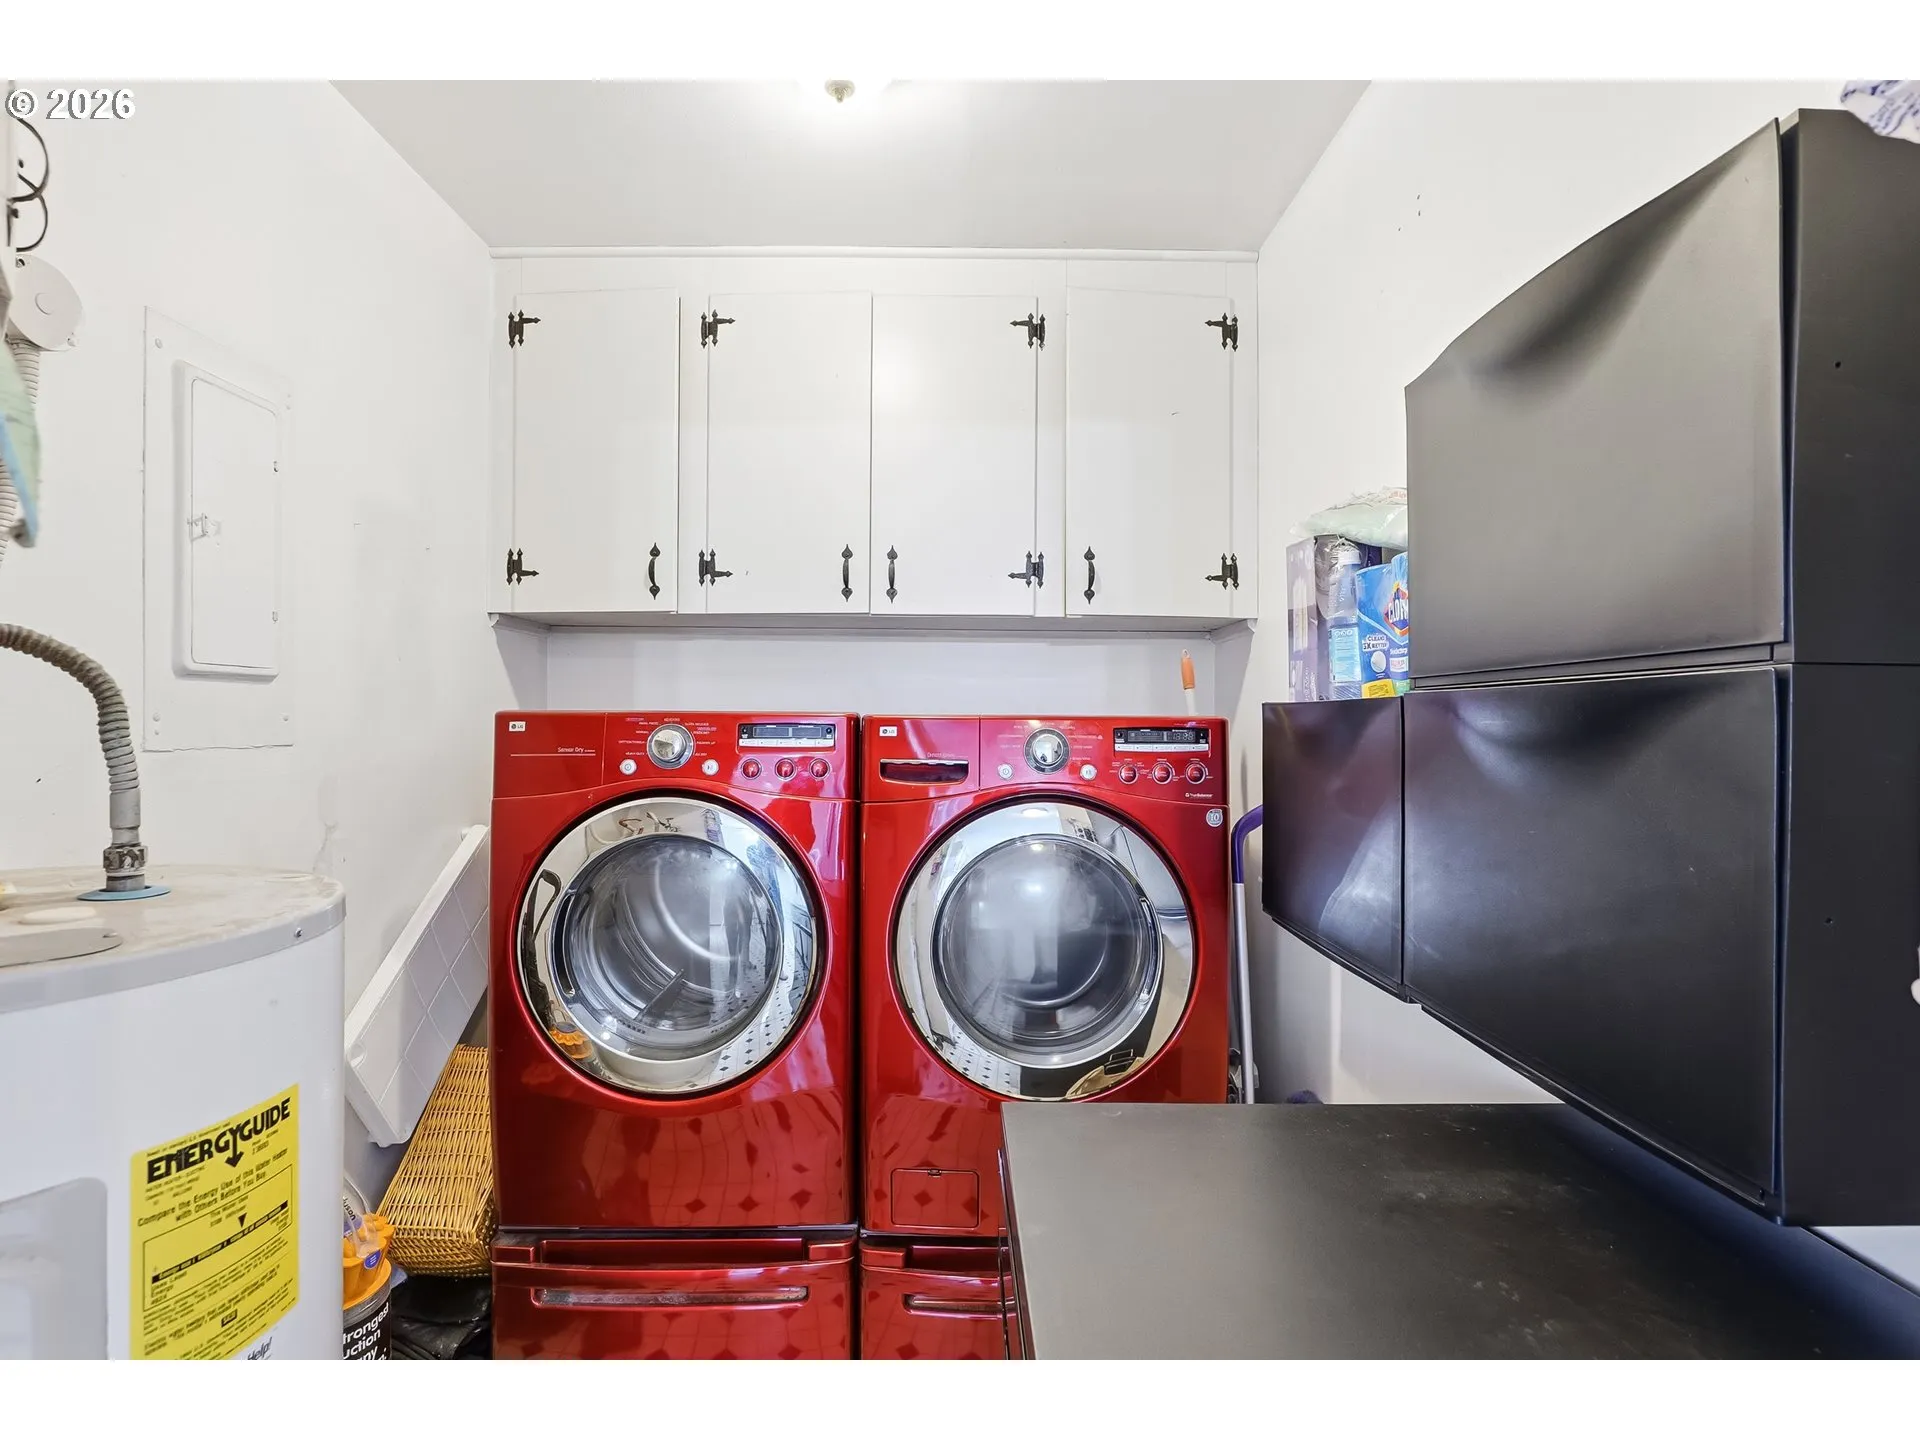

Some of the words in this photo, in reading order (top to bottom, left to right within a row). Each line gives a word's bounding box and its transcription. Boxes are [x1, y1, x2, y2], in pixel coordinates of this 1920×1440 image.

[147, 1097, 291, 1184] ENERGYGUIDE
[137, 1206, 176, 1227] Compare
[194, 1187, 218, 1204] Energy
